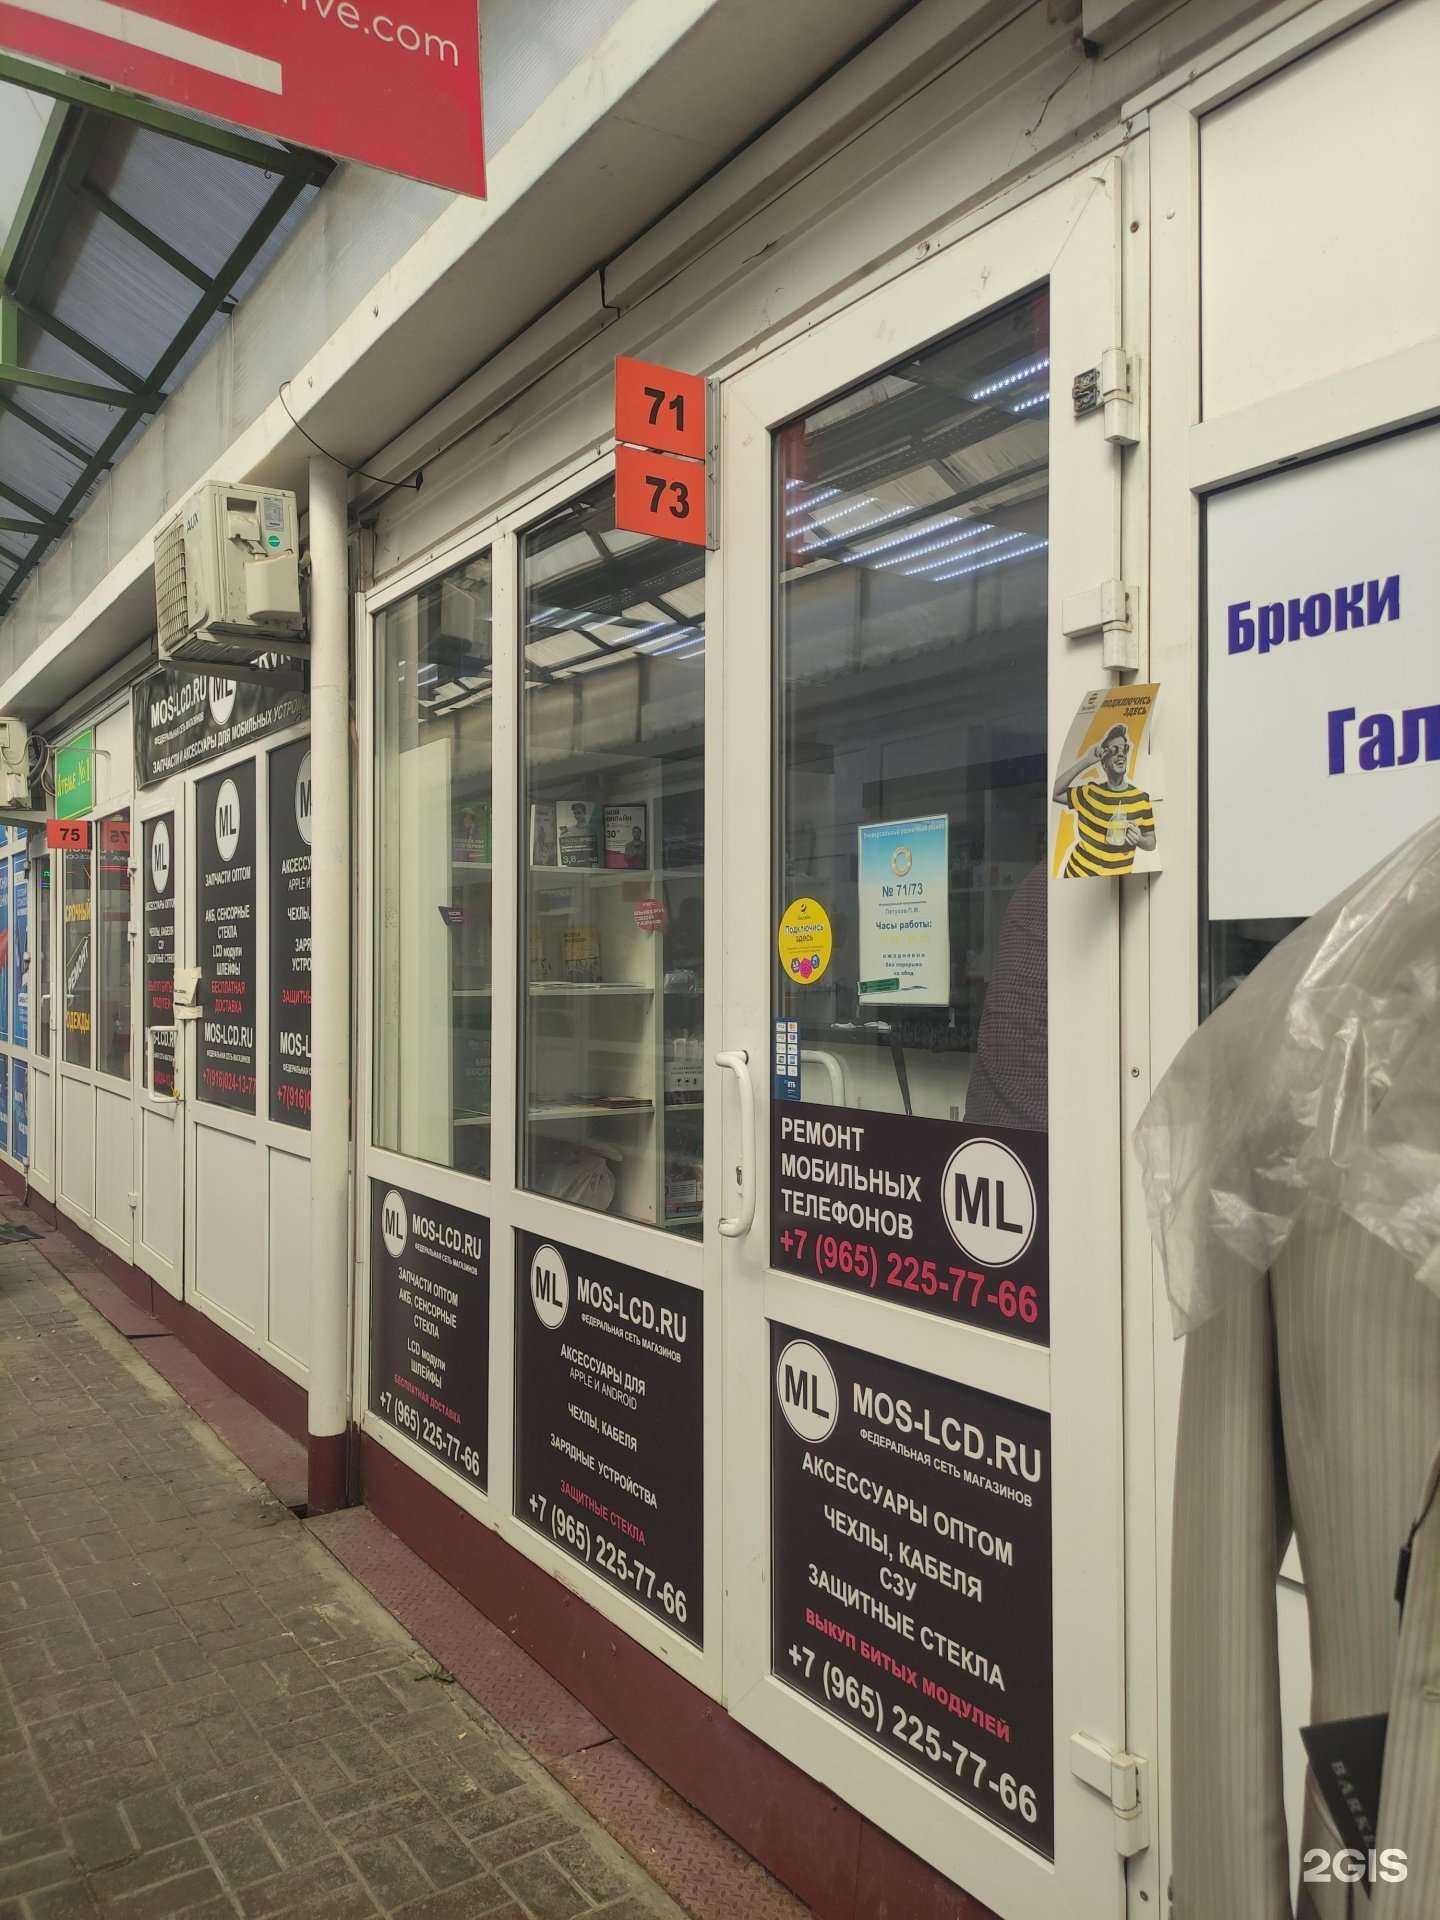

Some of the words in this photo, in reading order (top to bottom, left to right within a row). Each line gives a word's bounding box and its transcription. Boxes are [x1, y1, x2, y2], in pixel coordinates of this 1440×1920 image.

[277, 0, 458, 66] ve.com
[644, 387, 685, 431] 71
[645, 475, 690, 518] 73
[1228, 574, 1400, 655] Брюки
[151, 675, 207, 728] MOS-LCD.RU
[213, 677, 234, 703] ML
[183, 737, 217, 761] АКСЕССУАРЫ
[217, 730, 231, 749] ДЛЯ
[231, 710, 272, 741] МОБИЛЬНЫХ
[1328, 704, 1440, 775] Гал
[300, 779, 311, 818] M
[60, 828, 81, 841] 75
[218, 804, 237, 838] ML
[154, 843, 167, 873] ML
[205, 872, 231, 887] ЗАПЧАСТИ
[231, 866, 251, 881] ОПТОМ
[281, 856, 311, 875] АКСЕССУ
[882, 886, 894, 898] №
[896, 882, 923, 897] 71/73
[217, 904, 250, 921] СЕНСОРНЫЕ
[217, 925, 238, 939] СТЕКЛА
[875, 921, 897, 930] Часы
[899, 919, 933, 932] работы:
[212, 944, 223, 958] LCD
[292, 958, 311, 972] УСТРО
[295, 938, 311, 952] ЗАРЯ
[204, 1022, 253, 1048] MOS-LCD.RU
[280, 1032, 311, 1057] MOS-L
[781, 1117, 864, 1152] РЕМОНТ
[781, 1152, 922, 1202] МОБИЛЬНЫХ
[384, 1207, 404, 1240] ML
[781, 1188, 914, 1240] ТЕЛЕФОНОВ
[955, 1172, 1023, 1235] ML
[411, 1213, 483, 1261] MOS-LCD.RU
[398, 1267, 432, 1294] ЗАПЧАСТИ
[433, 1284, 459, 1308] ОПТОМ
[535, 1267, 563, 1309] ML
[780, 1227, 808, 1260] +7
[815, 1234, 879, 1289] (965)
[887, 1252, 1039, 1324] 225-77-66
[398, 1287, 413, 1310] АКБ,
[414, 1294, 457, 1329] СЕНСОРНЫЕ
[413, 1315, 440, 1340] СТЕКЛА
[577, 1276, 687, 1344] MOS-LCD.RU
[407, 1337, 420, 1356] LCD
[421, 1349, 446, 1372] модули
[581, 1312, 624, 1341] ФЕДЕРАЛЬНАЯ
[625, 1331, 641, 1349] СЕТЬ
[641, 1338, 682, 1364] МАГАЗИНОВ
[410, 1357, 442, 1390] ШЛЕЙФЫ
[560, 1343, 623, 1388] АКСЕССУАРЫ
[624, 1372, 647, 1396] ДЛЯ
[569, 1367, 593, 1391] APPLE
[601, 1381, 638, 1411] ANDROID
[785, 1363, 830, 1420] ML
[429, 1395, 461, 1426] ДОСТАВКА
[568, 1402, 600, 1436] ЧЕХЛЫ,
[601, 1417, 638, 1453] КАБЕЛЯ
[379, 1391, 392, 1414] +7
[394, 1398, 420, 1439] (965)
[422, 1414, 480, 1477] 225-77-66
[852, 1382, 1042, 1484] MOS-LCD.RU
[550, 1433, 596, 1472] ЗАРЯДНЫЕ
[597, 1459, 658, 1510] УСТРОЙСТВА
[859, 1428, 931, 1468] ФЕДЕРАЛЬНАЯ
[933, 1456, 962, 1478] СЕТЬ
[963, 1469, 1034, 1508] МАГАЗИНОВ
[560, 1479, 608, 1521] ЗАЩИТНЫЕ
[610, 1511, 647, 1546] СТЕКЛА
[801, 1451, 928, 1528] АКСЕССУАРЫ
[933, 1510, 1014, 1567] ОПТОМ
[529, 1492, 548, 1522] +7
[551, 1504, 592, 1562] (965)
[596, 1535, 688, 1625] 225-77-66
[824, 1503, 893, 1562] ЧЕХЛЫ,
[898, 1543, 983, 1602] КАБЕЛЯ
[879, 1566, 917, 1601] СЗУ
[808, 1563, 915, 1641] ЗАЩИТНЫЕ
[920, 1624, 1006, 1692] СТЕКЛА
[805, 1607, 857, 1651] ВЫКУП
[860, 1640, 918, 1688] БИТЫХ
[922, 1677, 1011, 1744] МОДУЛЕЙ
[788, 1642, 816, 1680] +7
[822, 1659, 885, 1733] (965)
[892, 1704, 1039, 1824] 225-77-66
